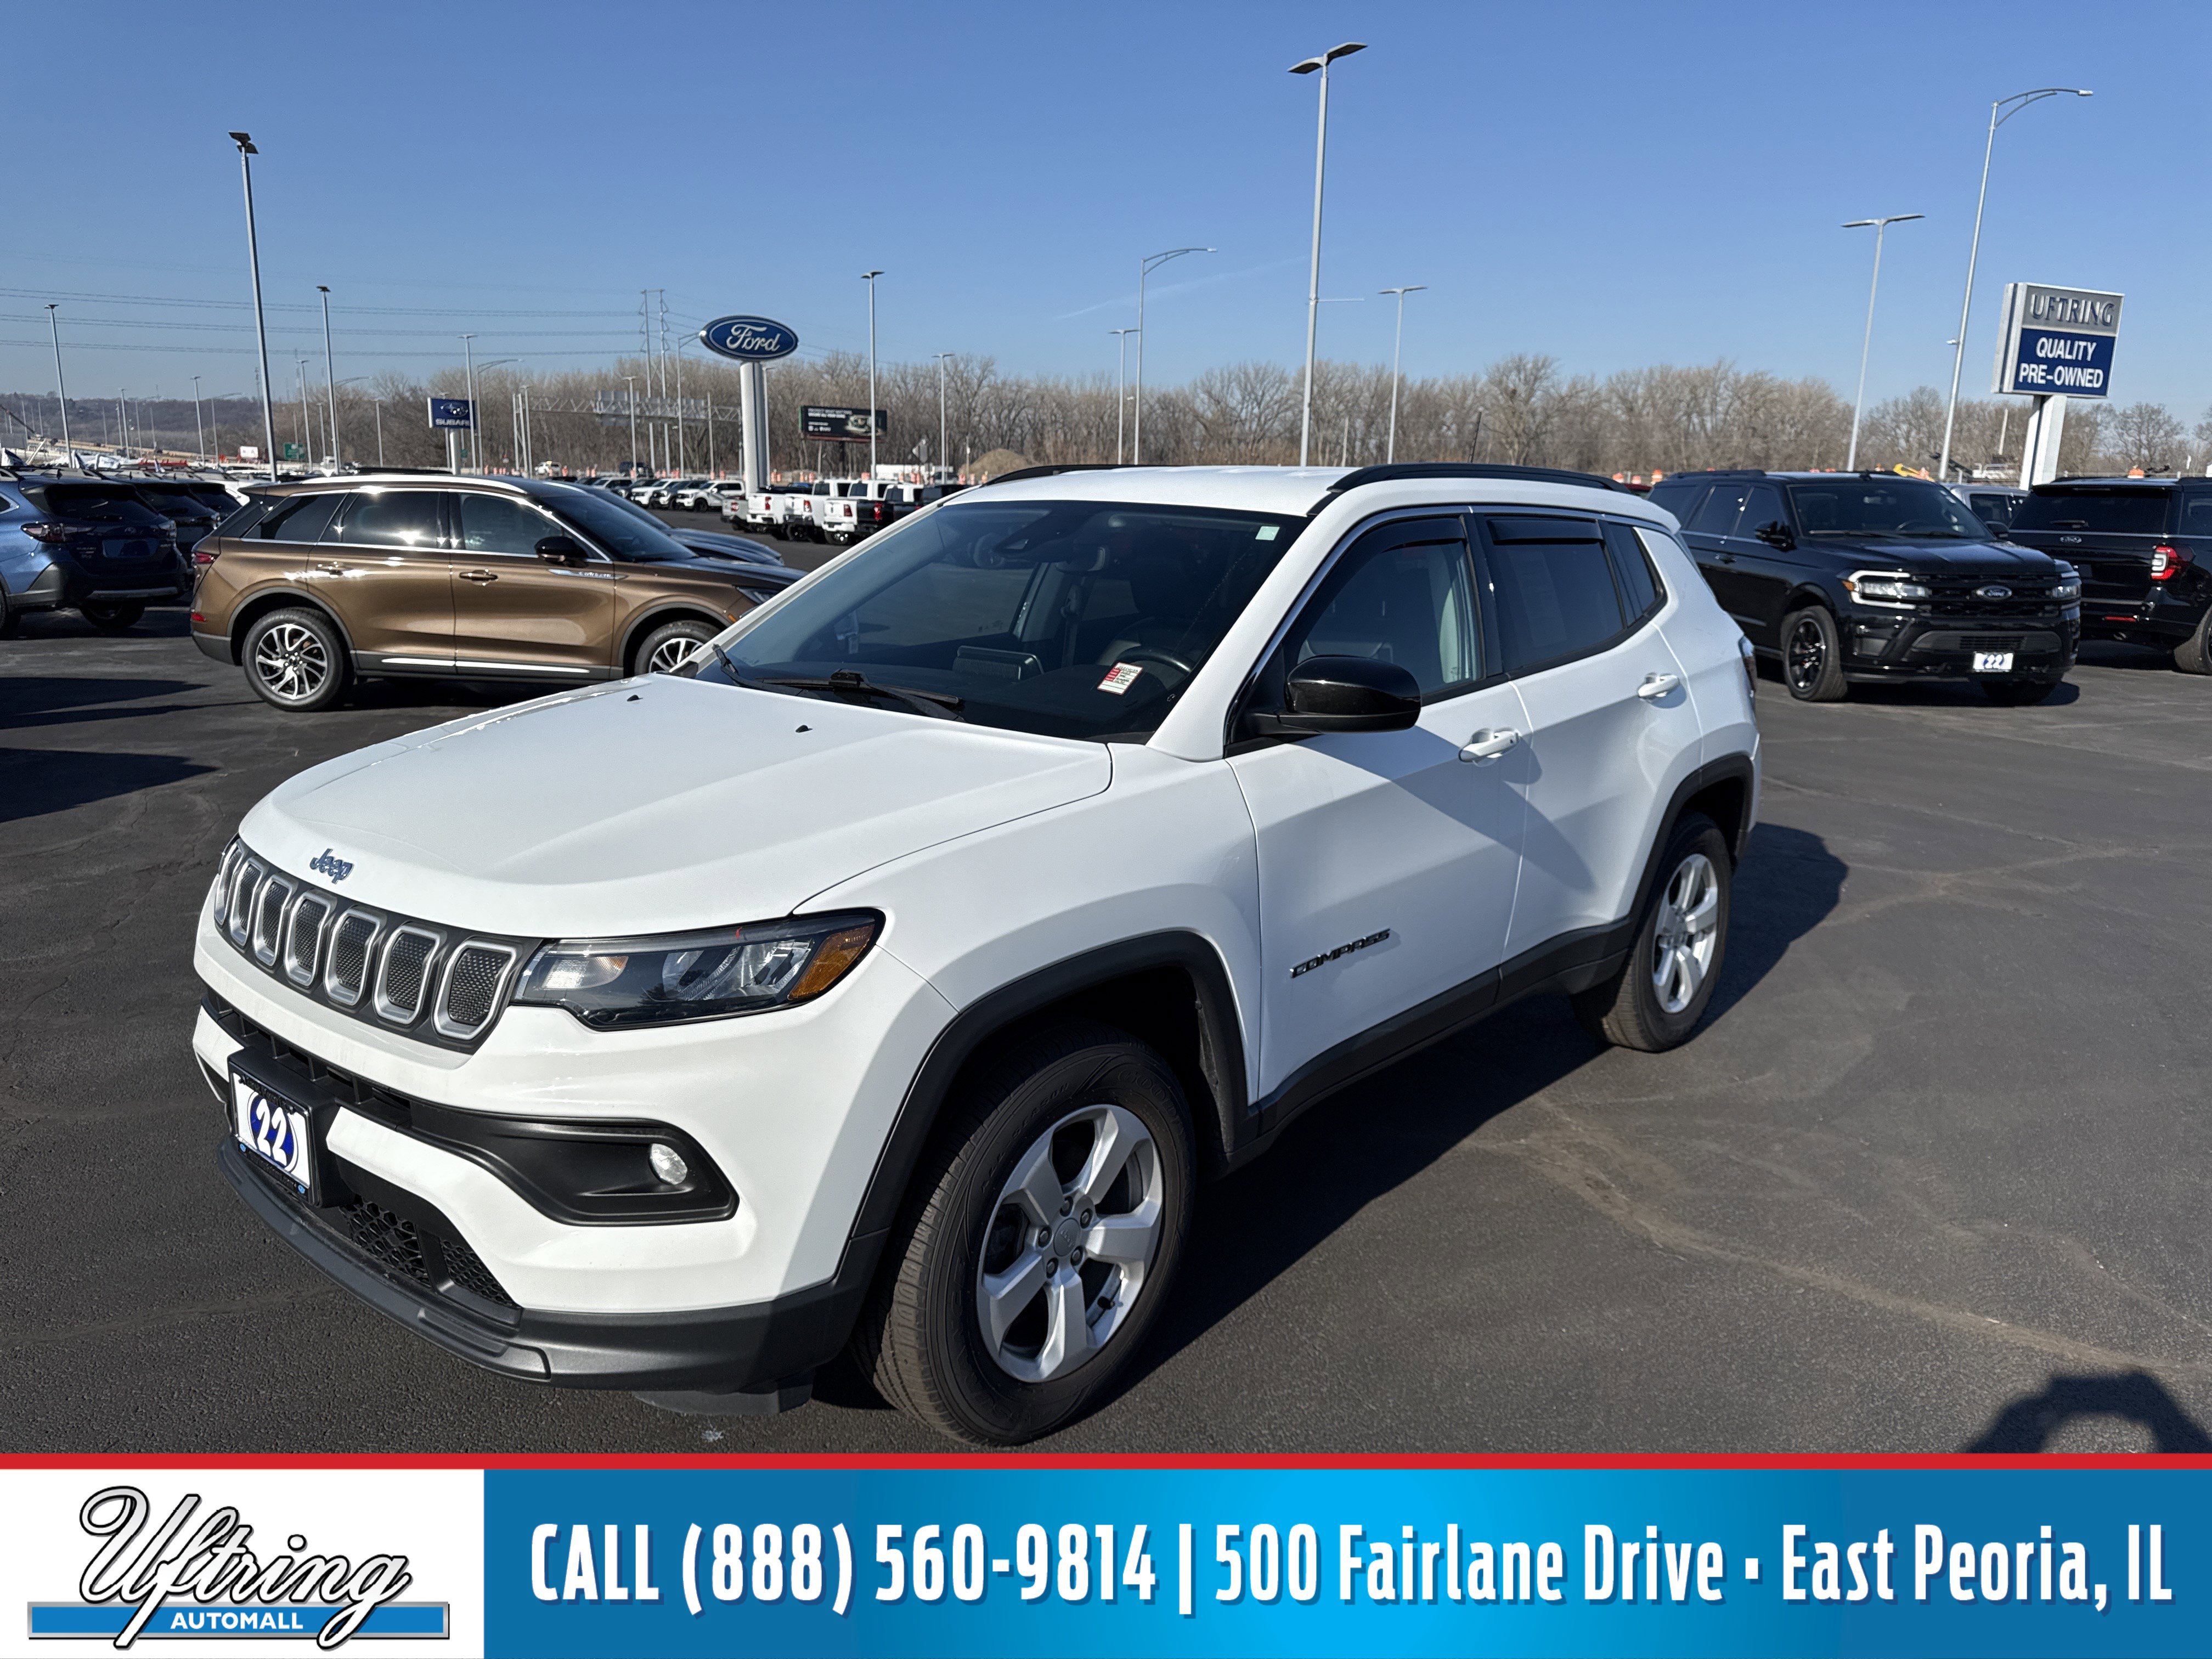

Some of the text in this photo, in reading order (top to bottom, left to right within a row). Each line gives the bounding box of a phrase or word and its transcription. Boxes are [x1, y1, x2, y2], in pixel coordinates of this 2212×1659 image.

[2030, 294, 2114, 326] UFTRING
[726, 323, 782, 352] Ford
[2035, 336, 2097, 362] QUALITY
[2018, 363, 2104, 388] PRE-OWNED
[1984, 654, 2003, 669] 22
[309, 848, 354, 884] Jeep
[1290, 927, 1391, 979] COMPASS
[256, 1098, 287, 1166] 22
